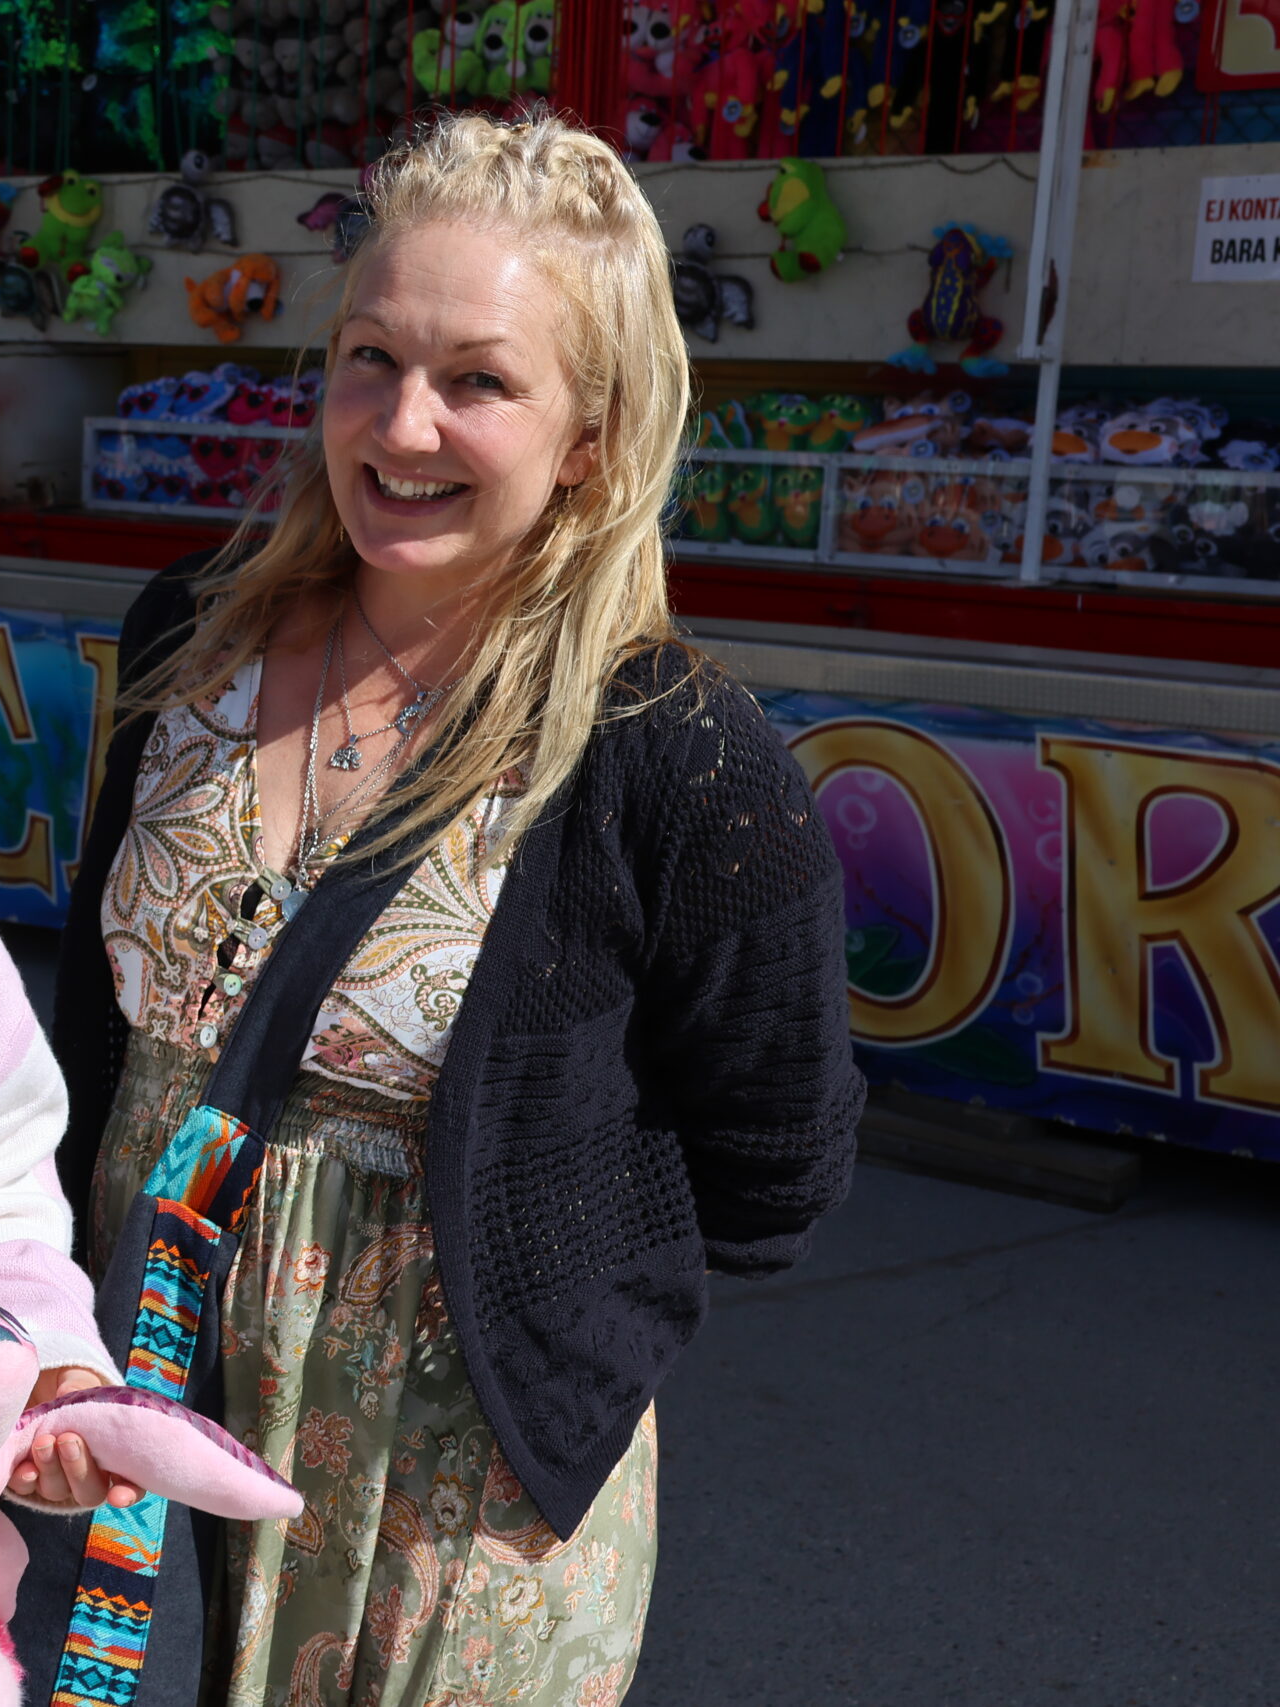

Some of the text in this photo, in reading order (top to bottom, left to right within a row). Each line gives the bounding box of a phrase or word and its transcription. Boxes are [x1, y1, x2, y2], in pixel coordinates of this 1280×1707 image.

[1206, 197, 1280, 222] EJ KONT
[1210, 238, 1266, 264] BARA
